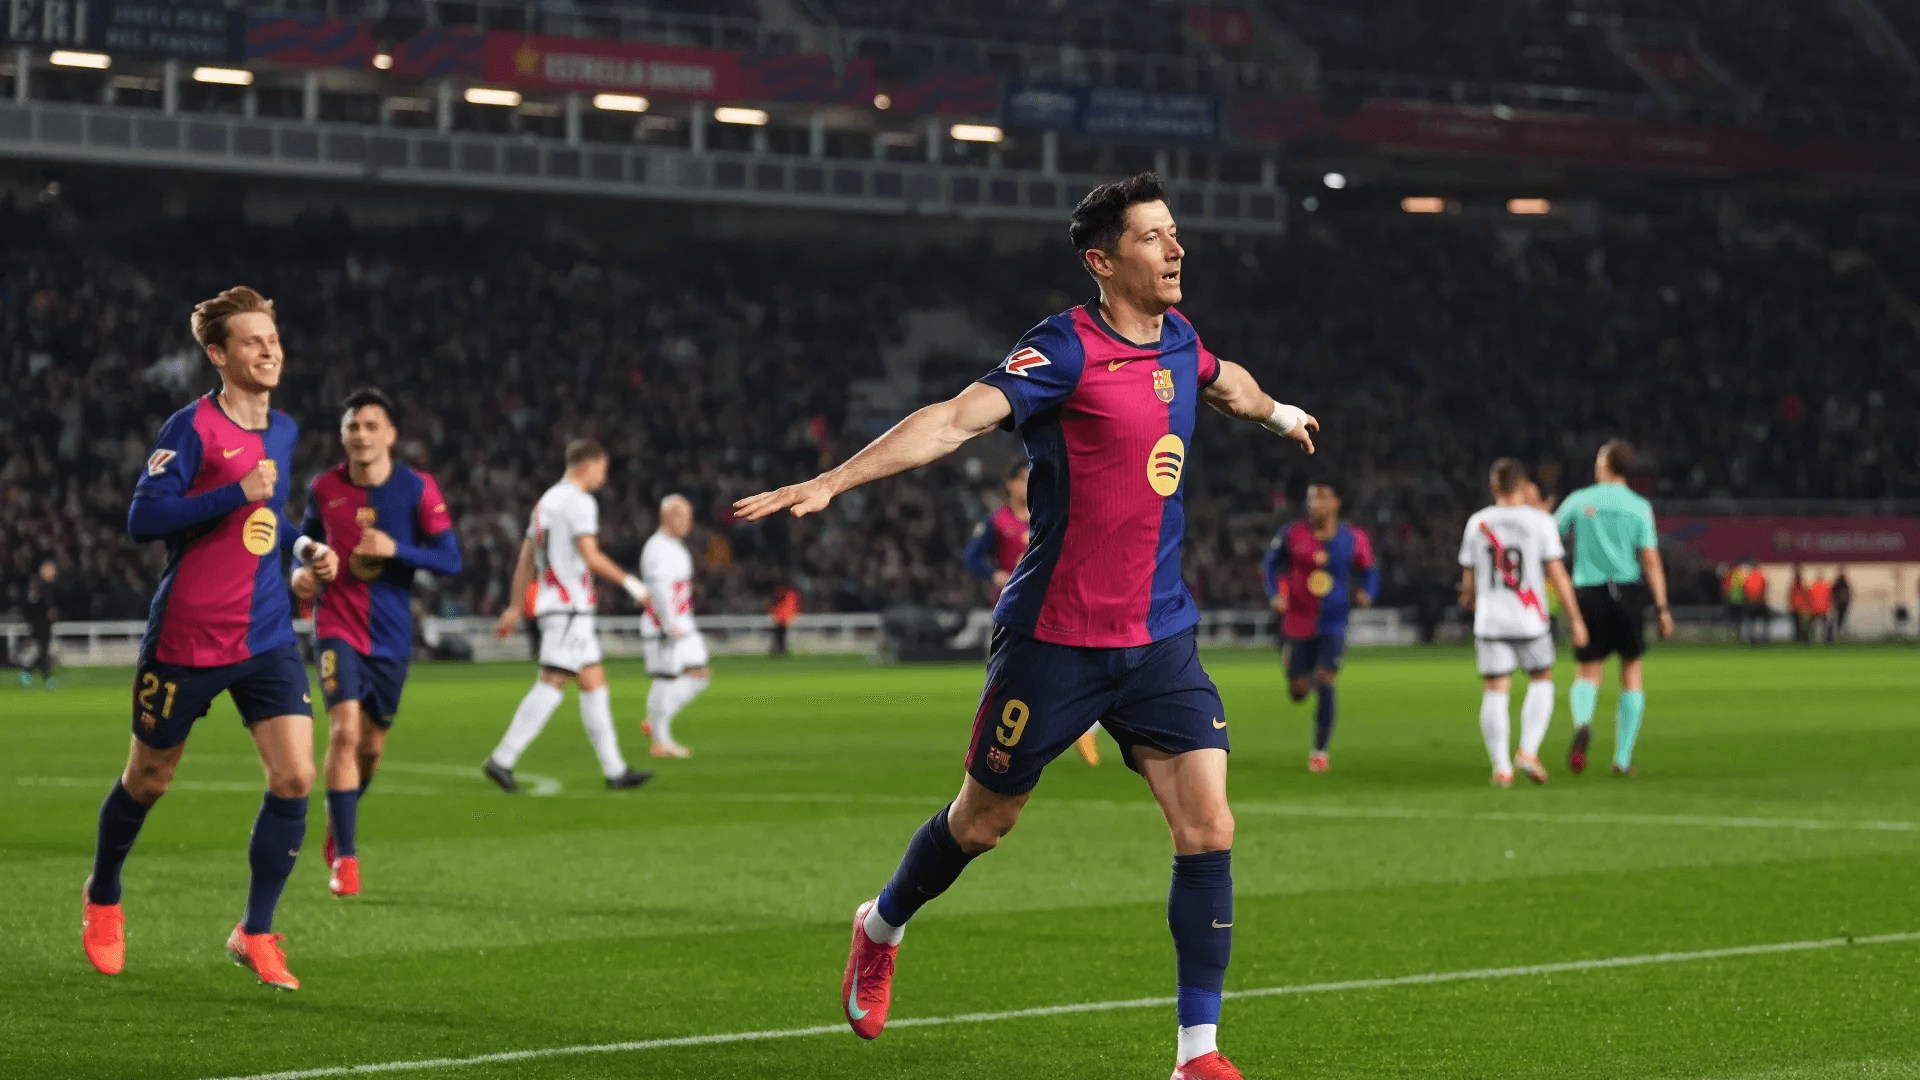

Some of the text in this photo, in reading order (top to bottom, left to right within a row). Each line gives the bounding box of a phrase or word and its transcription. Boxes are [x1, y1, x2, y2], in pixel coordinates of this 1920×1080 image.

[1487, 545, 1523, 591] 19
[321, 649, 336, 678] 8
[139, 671, 177, 719] 21
[996, 699, 1030, 747] 9
